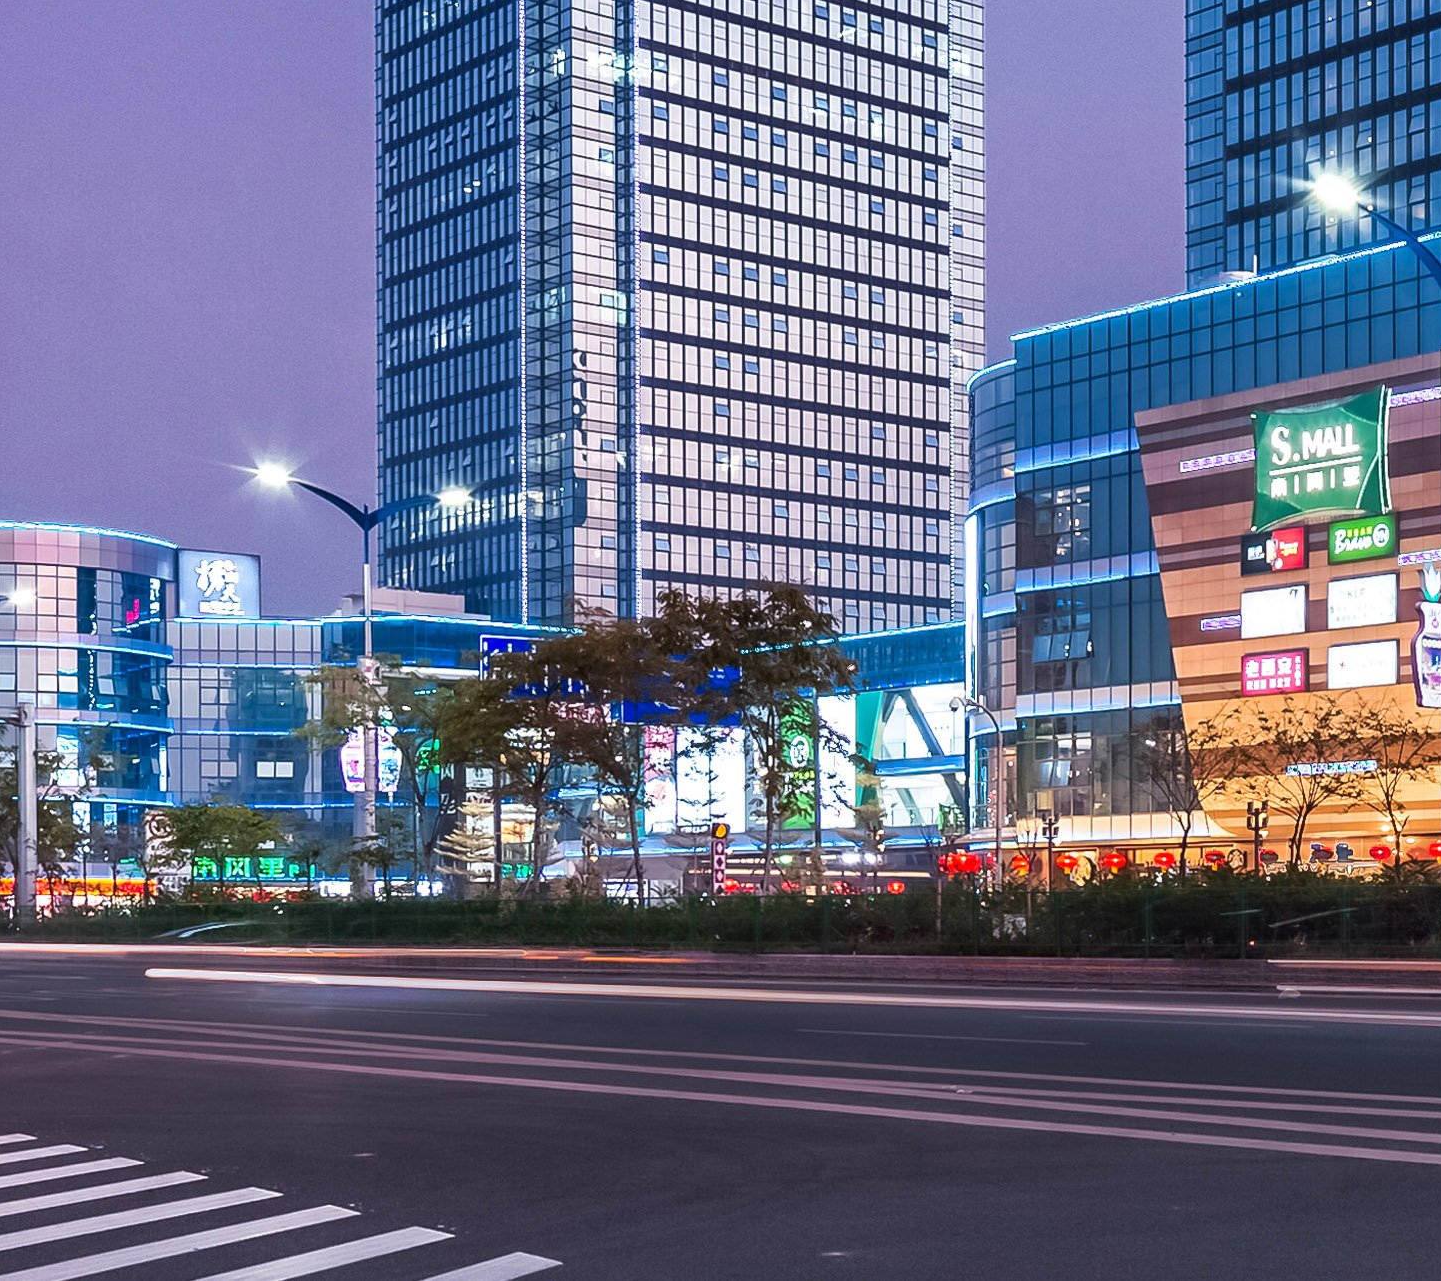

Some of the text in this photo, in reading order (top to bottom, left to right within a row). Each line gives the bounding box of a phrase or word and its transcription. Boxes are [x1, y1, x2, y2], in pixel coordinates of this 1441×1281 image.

[1270, 423, 1361, 466] S.MALL
[193, 856, 286, 878] 南风里
